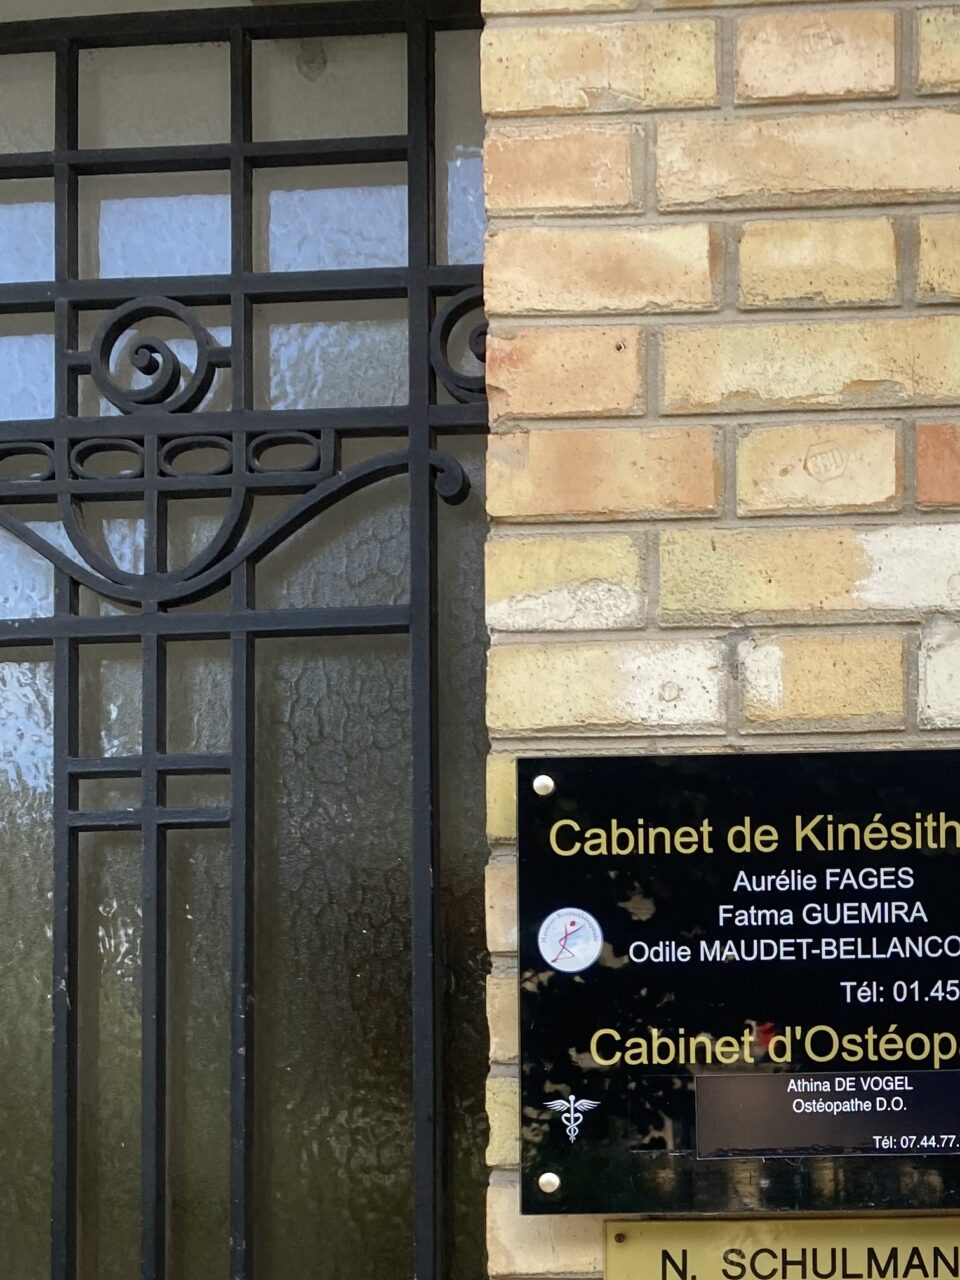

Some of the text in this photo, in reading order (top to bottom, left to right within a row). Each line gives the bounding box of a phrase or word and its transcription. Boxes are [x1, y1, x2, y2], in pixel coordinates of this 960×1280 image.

[549, 818, 714, 856] Cabinet
[727, 816, 779, 853] de
[732, 867, 915, 892] Aurélie FAGES
[718, 901, 929, 927] Fatma GUEMIRA
[628, 940, 692, 963] Odile
[839, 981, 885, 1003] Tél:
[590, 1027, 757, 1066] Cabinet
[786, 1075, 914, 1094] Athina DE VOGEL
[792, 1096, 907, 1116] Ostéopathe D.O.
[872, 1134, 898, 1150] Tél:
[661, 1249, 697, 1280] N.
